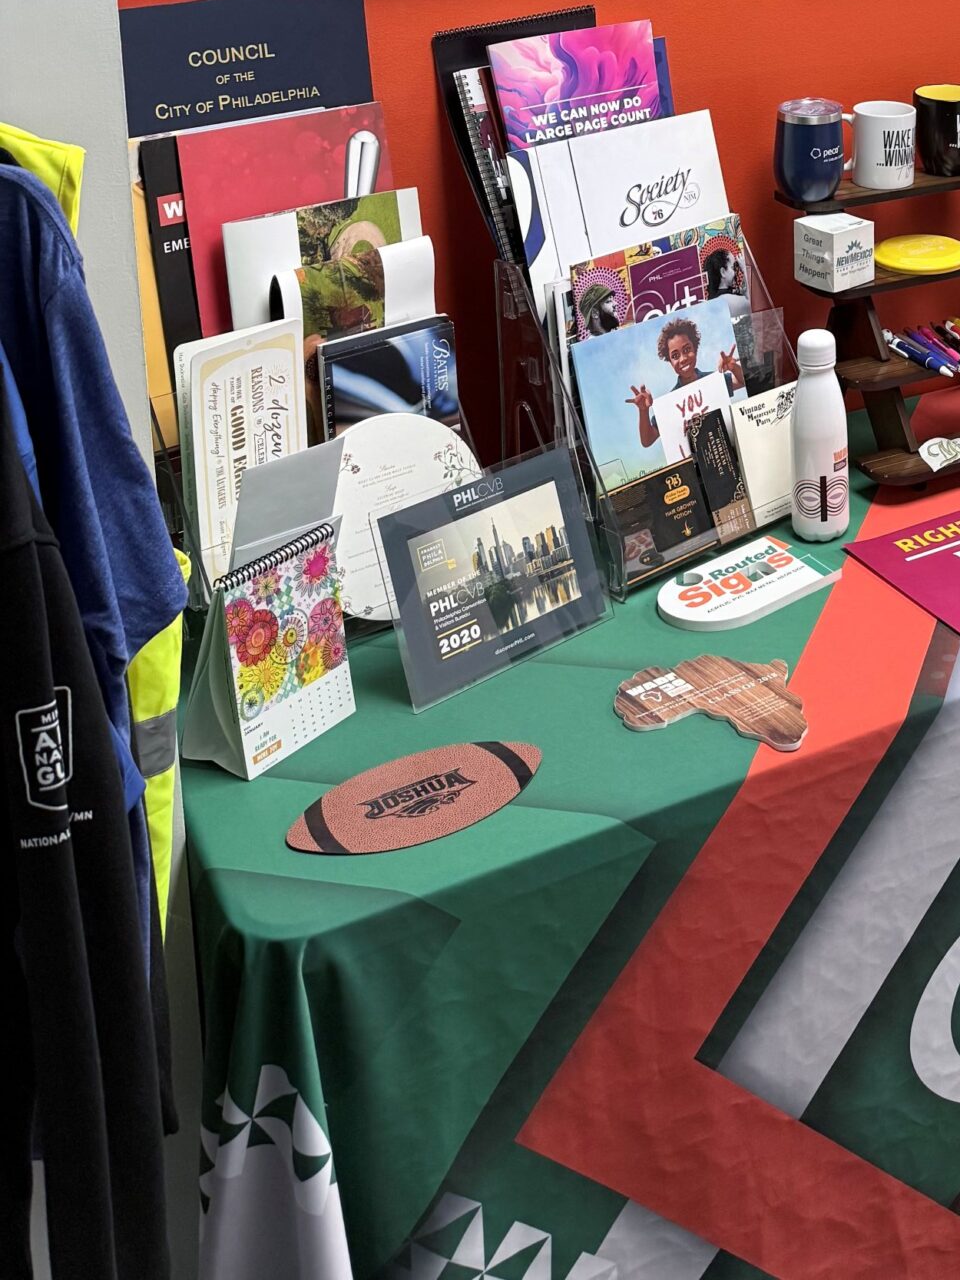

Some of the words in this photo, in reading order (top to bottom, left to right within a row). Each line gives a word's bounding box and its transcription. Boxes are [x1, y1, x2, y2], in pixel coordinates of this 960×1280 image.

[188, 43, 275, 68] COUNCIL
[216, 75, 230, 85] OF
[233, 71, 255, 82] THE
[196, 101, 214, 115] OF
[218, 86, 320, 111] PHILADELPHIA
[532, 114, 557, 127] WE
[561, 108, 588, 121] CAN
[591, 102, 620, 116] NOW
[623, 96, 642, 108] DO
[525, 125, 572, 144] LARGE
[576, 119, 608, 133] PAGE
[610, 108, 651, 125] COUNT
[883, 130, 910, 149] WAKE
[619, 167, 691, 228] Society
[803, 233, 823, 248] Great
[802, 248, 825, 265] Things
[739, 402, 765, 416] Vintage
[709, 546, 778, 580] Routed
[677, 551, 794, 608] Signs
[439, 624, 481, 653] 2020
[365, 771, 465, 819] JOSHUA
